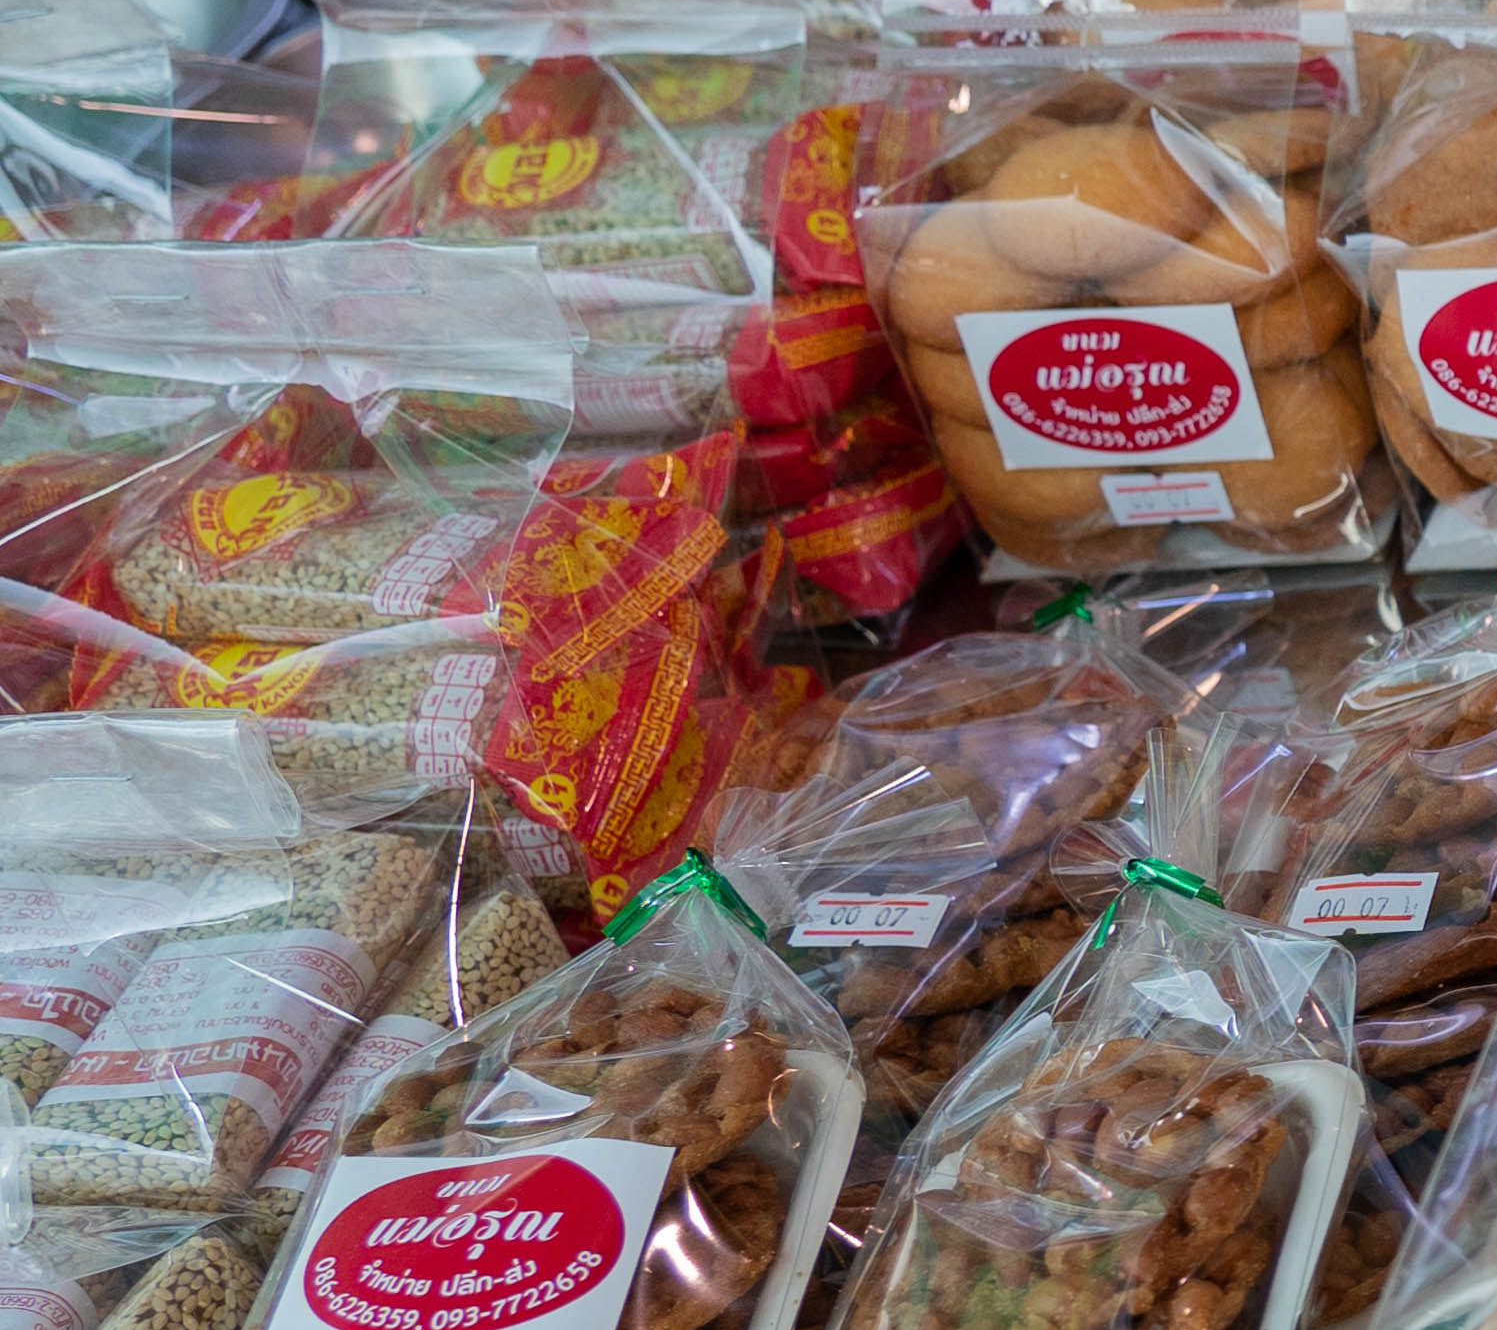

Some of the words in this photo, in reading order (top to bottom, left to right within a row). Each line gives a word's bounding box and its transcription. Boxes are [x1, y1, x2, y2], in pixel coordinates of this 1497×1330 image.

[1060, 330, 1121, 352] ขนม
[1050, 396, 1121, 427] จำหน่าย
[436, 1173, 512, 1198] ขนม
[363, 1197, 566, 1262] แม่อรุณ
[357, 1259, 432, 1297] จำหน่าย
[440, 1257, 538, 1297] ปลีก-ส่ง
[429, 1249, 603, 1330] 093-7722658
